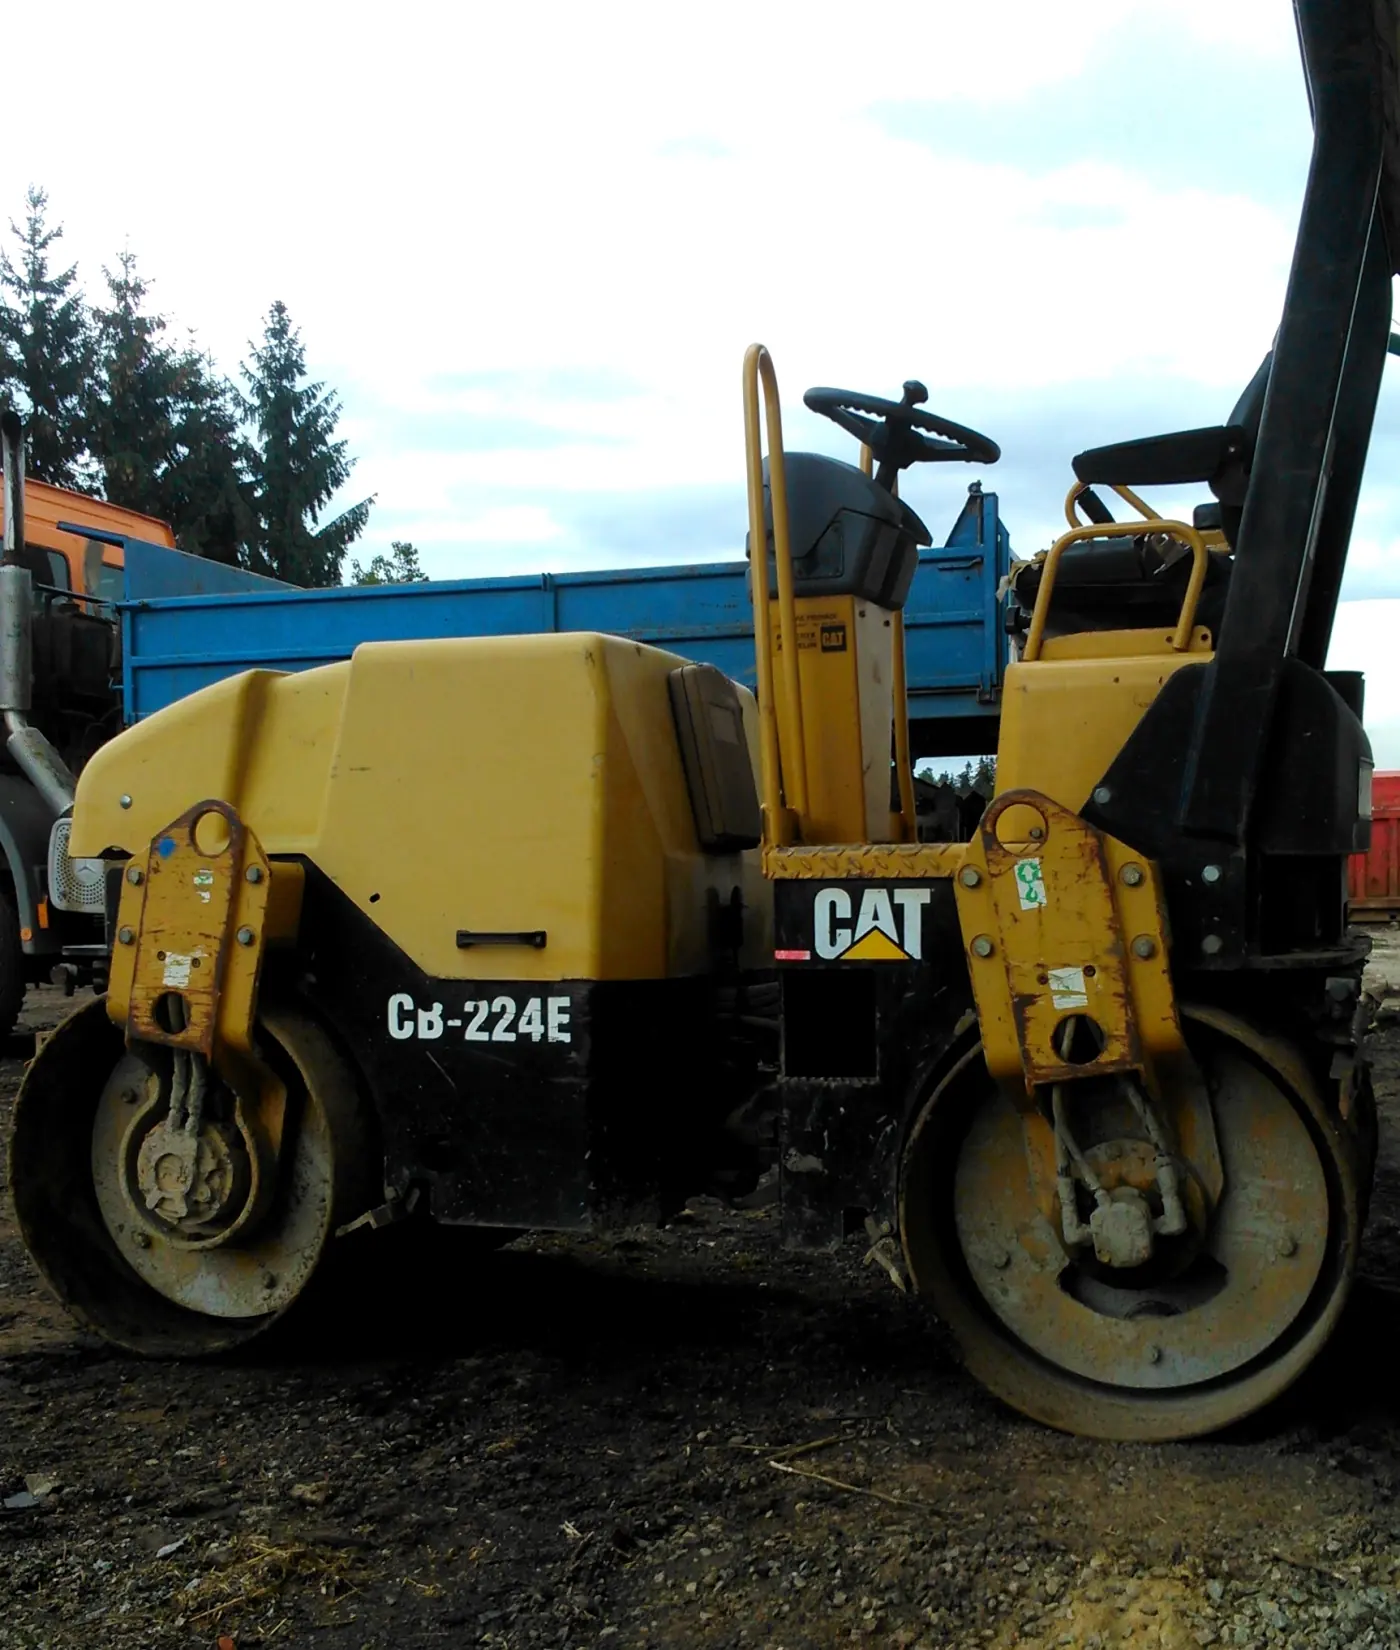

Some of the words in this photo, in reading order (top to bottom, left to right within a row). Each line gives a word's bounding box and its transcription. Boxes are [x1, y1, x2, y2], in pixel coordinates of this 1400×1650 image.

[822, 631, 844, 646] CAT
[814, 887, 931, 960] CAT
[387, 993, 572, 1043] CB-224E
